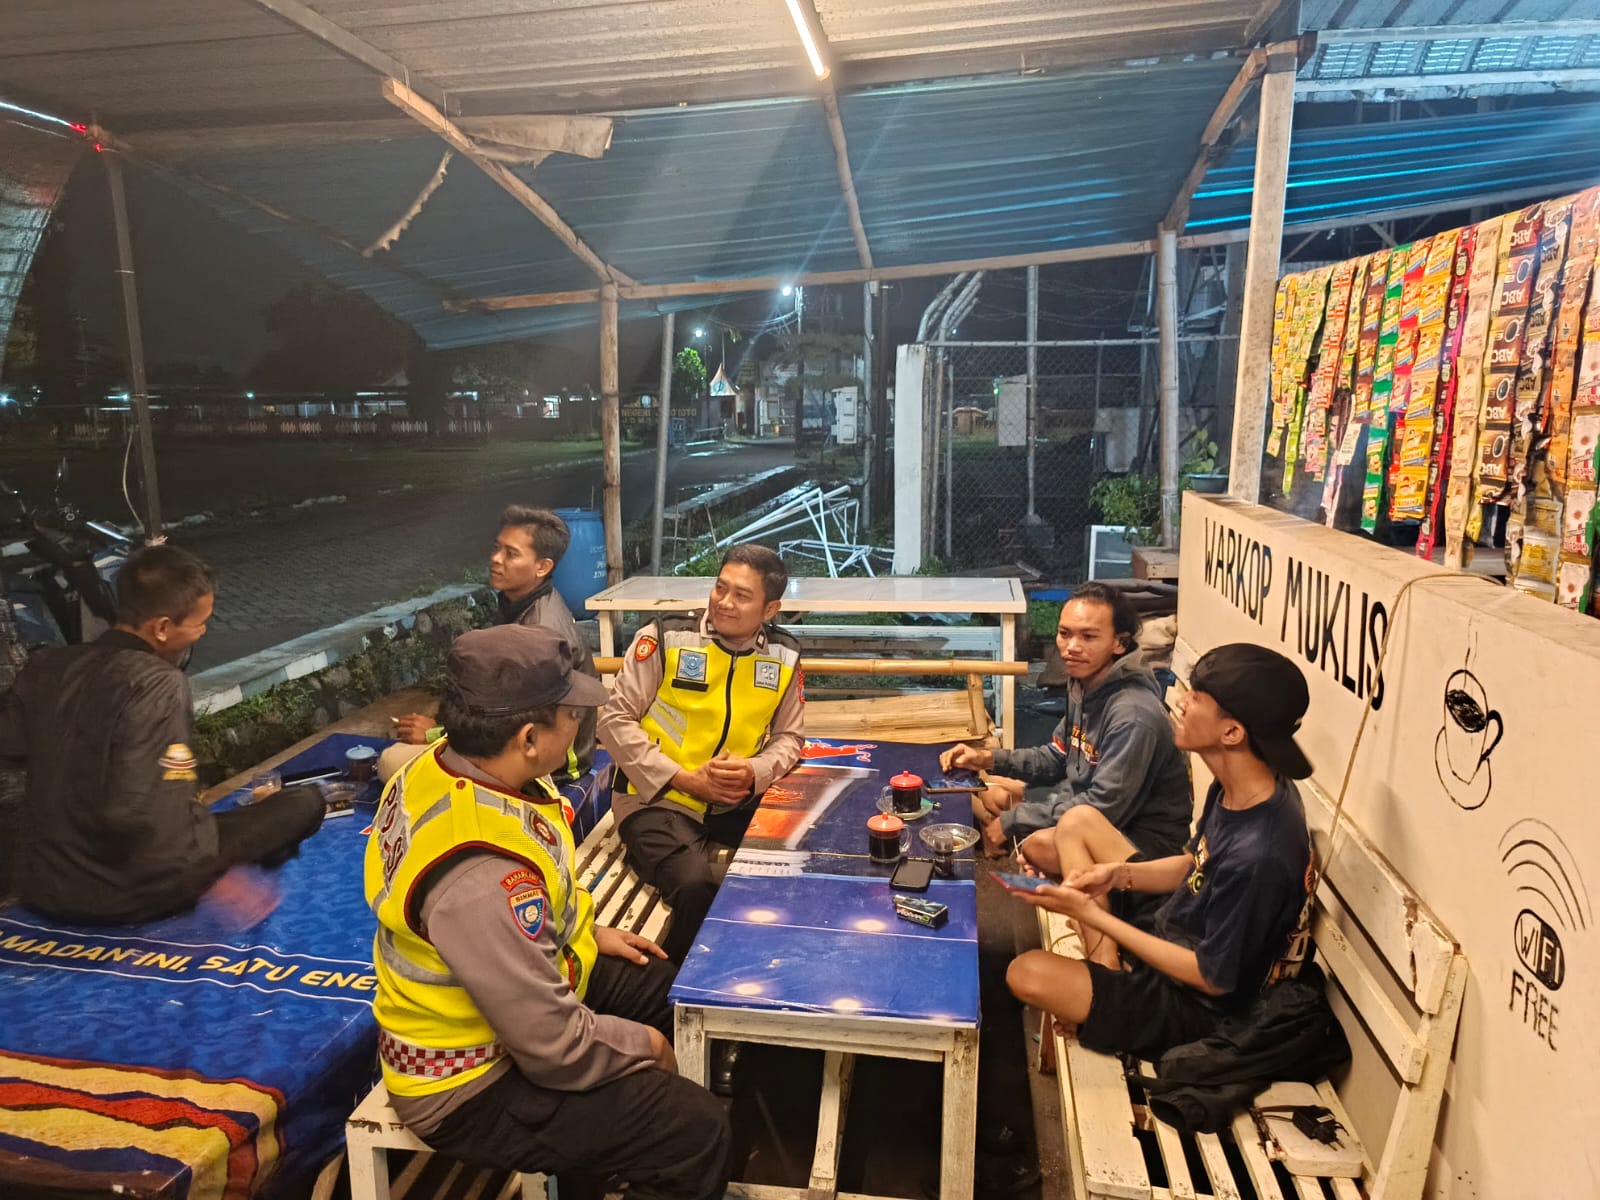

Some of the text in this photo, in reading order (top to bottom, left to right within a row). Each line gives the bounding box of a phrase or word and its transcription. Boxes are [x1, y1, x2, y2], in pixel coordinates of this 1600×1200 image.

[1510, 228, 1532, 247] ABC
[1502, 288, 1526, 305] ABC
[1491, 347, 1517, 363] ABC
[1485, 406, 1508, 420] ABC
[1478, 463, 1503, 476] ABC
[1205, 517, 1388, 711] WARKOP MUKLIS
[1519, 917, 1562, 985] WIFI
[0, 931, 379, 991] MADAN INI, SATU ENE
[1509, 969, 1559, 1052] FREE
